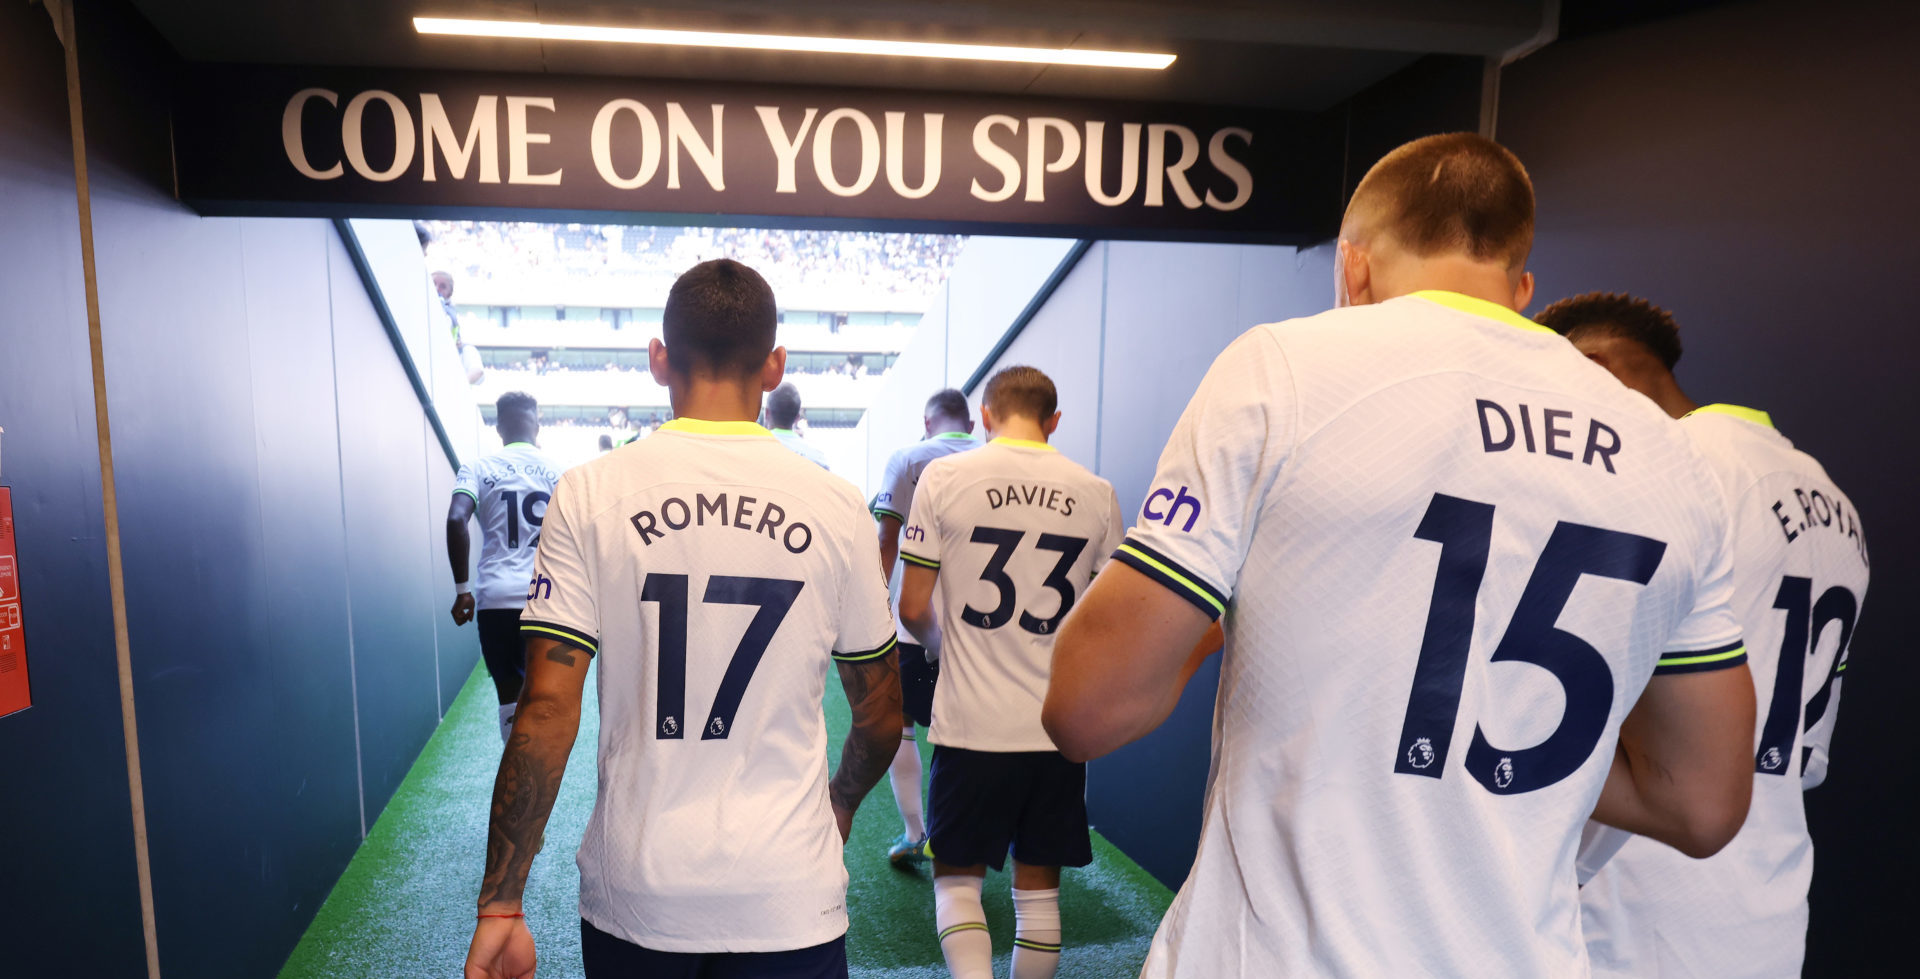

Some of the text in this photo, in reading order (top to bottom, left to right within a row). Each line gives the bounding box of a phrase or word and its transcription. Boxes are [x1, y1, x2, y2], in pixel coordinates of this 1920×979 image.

[281, 87, 1254, 212] COME ON YOU SPURS
[1475, 398, 1623, 475] DIER
[500, 490, 553, 549] 19
[629, 492, 813, 555] ROMERO
[905, 524, 926, 543] ch
[985, 484, 1076, 517] DAVIES
[1142, 485, 1201, 533] ch
[961, 526, 1089, 636] 33
[640, 572, 806, 741] 17
[1393, 491, 1668, 796] 15
[1755, 575, 1857, 778] 12
